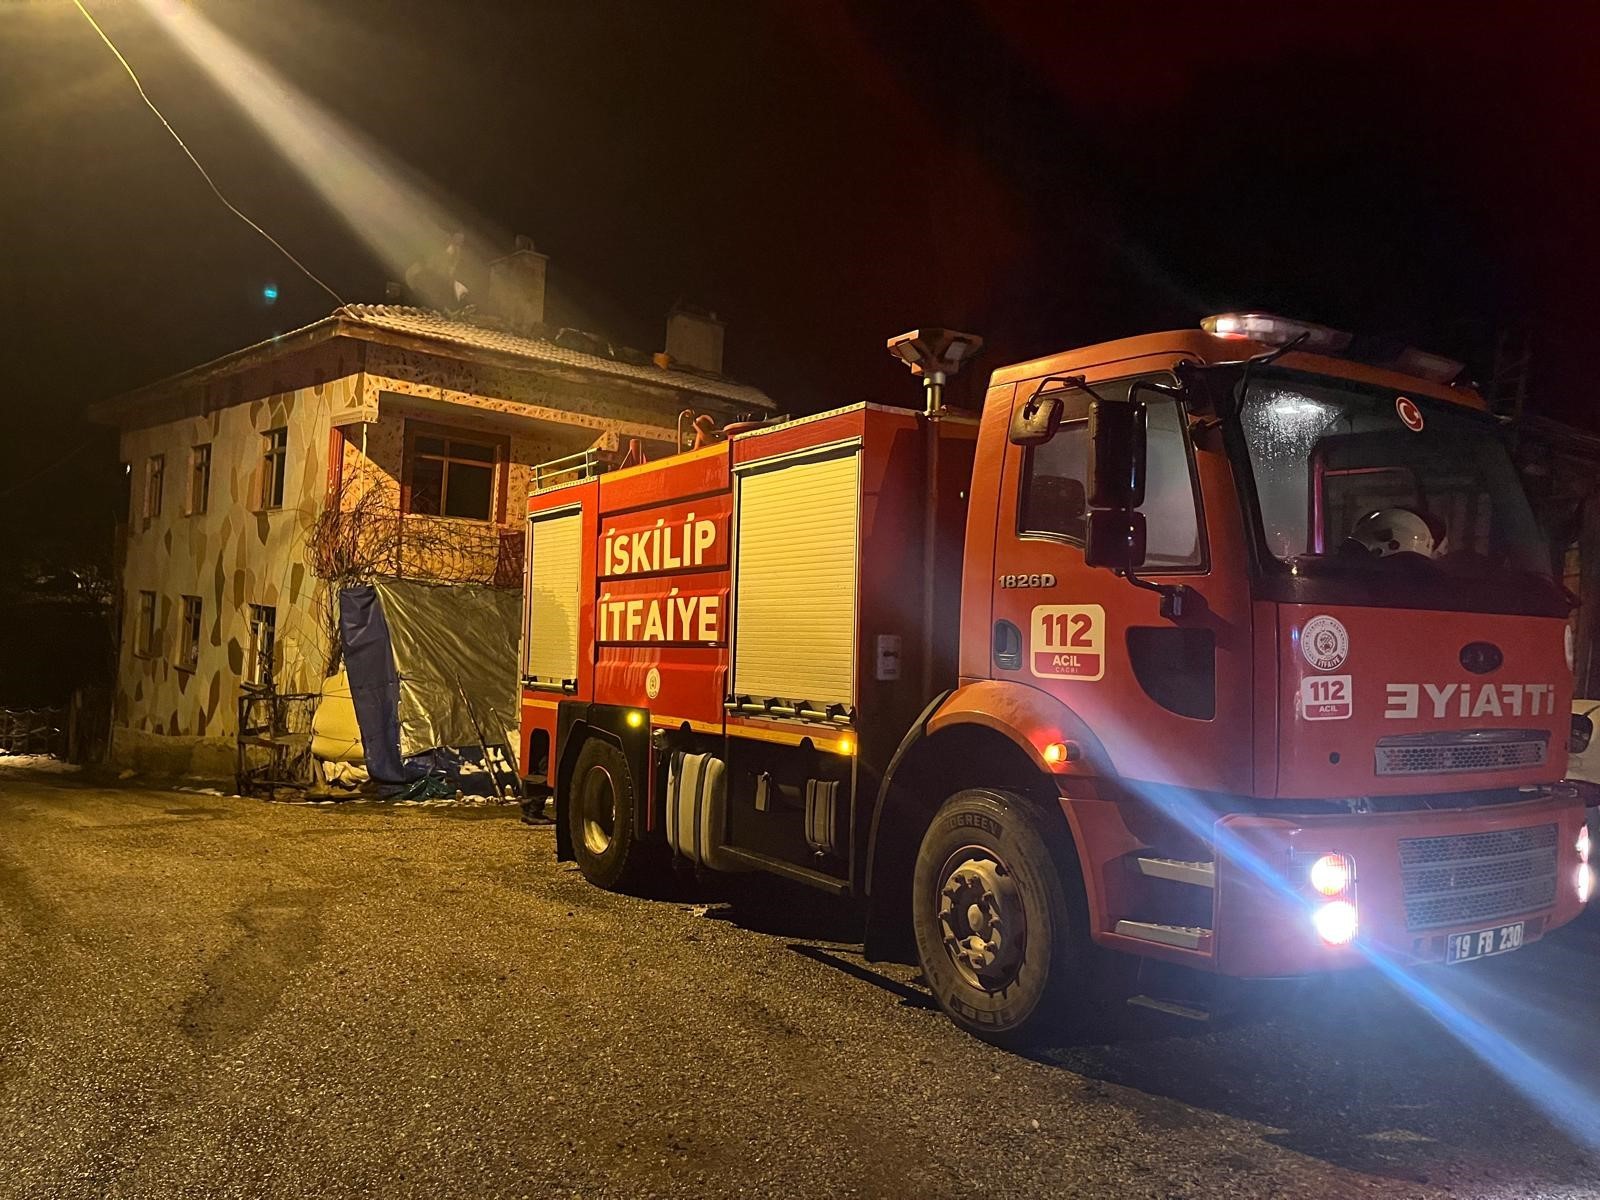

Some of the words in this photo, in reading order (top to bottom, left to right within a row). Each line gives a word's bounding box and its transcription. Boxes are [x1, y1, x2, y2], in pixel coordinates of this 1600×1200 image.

[604, 512, 716, 576] İSKİLİP
[998, 573, 1056, 589] 1826D
[600, 587, 719, 641] İTFAİYE
[1041, 613, 1093, 647] 112
[1310, 681, 1344, 701] 112
[1455, 935, 1471, 959] 19
[1477, 930, 1494, 955] FB
[1499, 924, 1521, 950] 230
